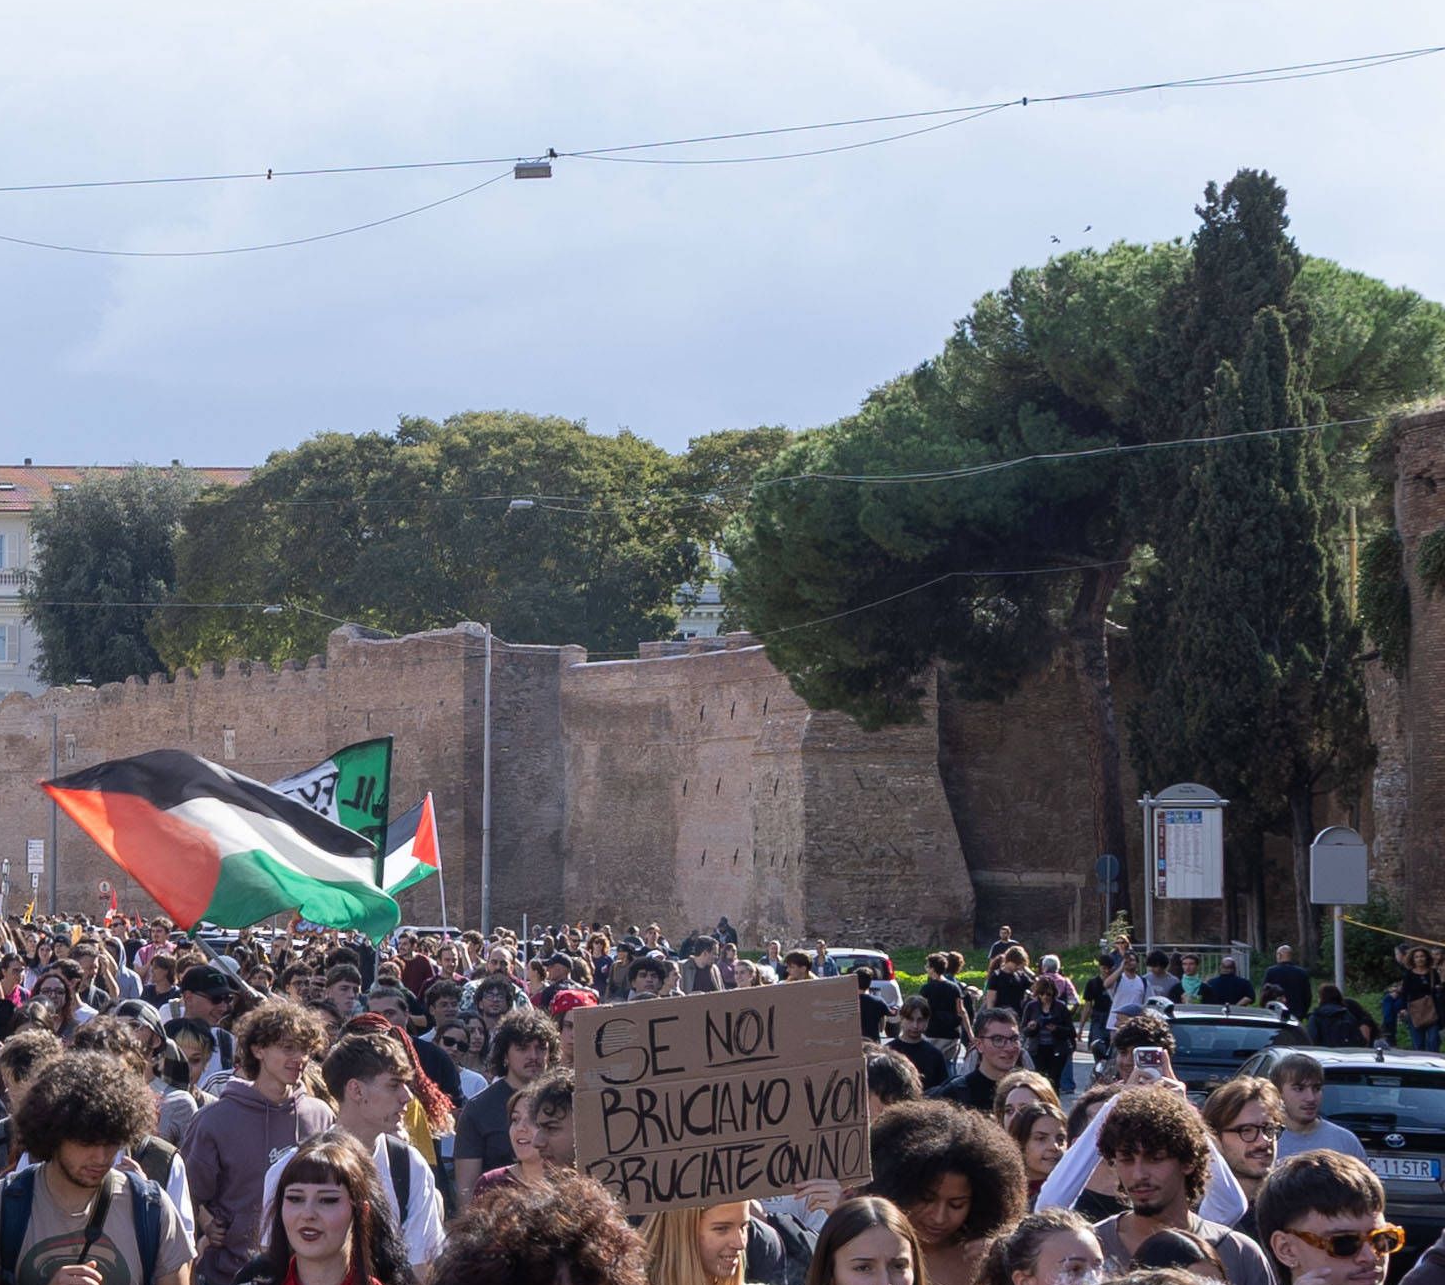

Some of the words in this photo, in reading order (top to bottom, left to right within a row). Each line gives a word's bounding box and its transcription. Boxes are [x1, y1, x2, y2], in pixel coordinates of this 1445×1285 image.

[595, 1016, 686, 1084] SE
[705, 1005, 775, 1057] NOI
[601, 1078, 791, 1155] BRUCIAMO
[585, 1144, 765, 1204] BRUCIATE
[767, 1142, 813, 1188] CON
[818, 1128, 866, 1179] NOI
